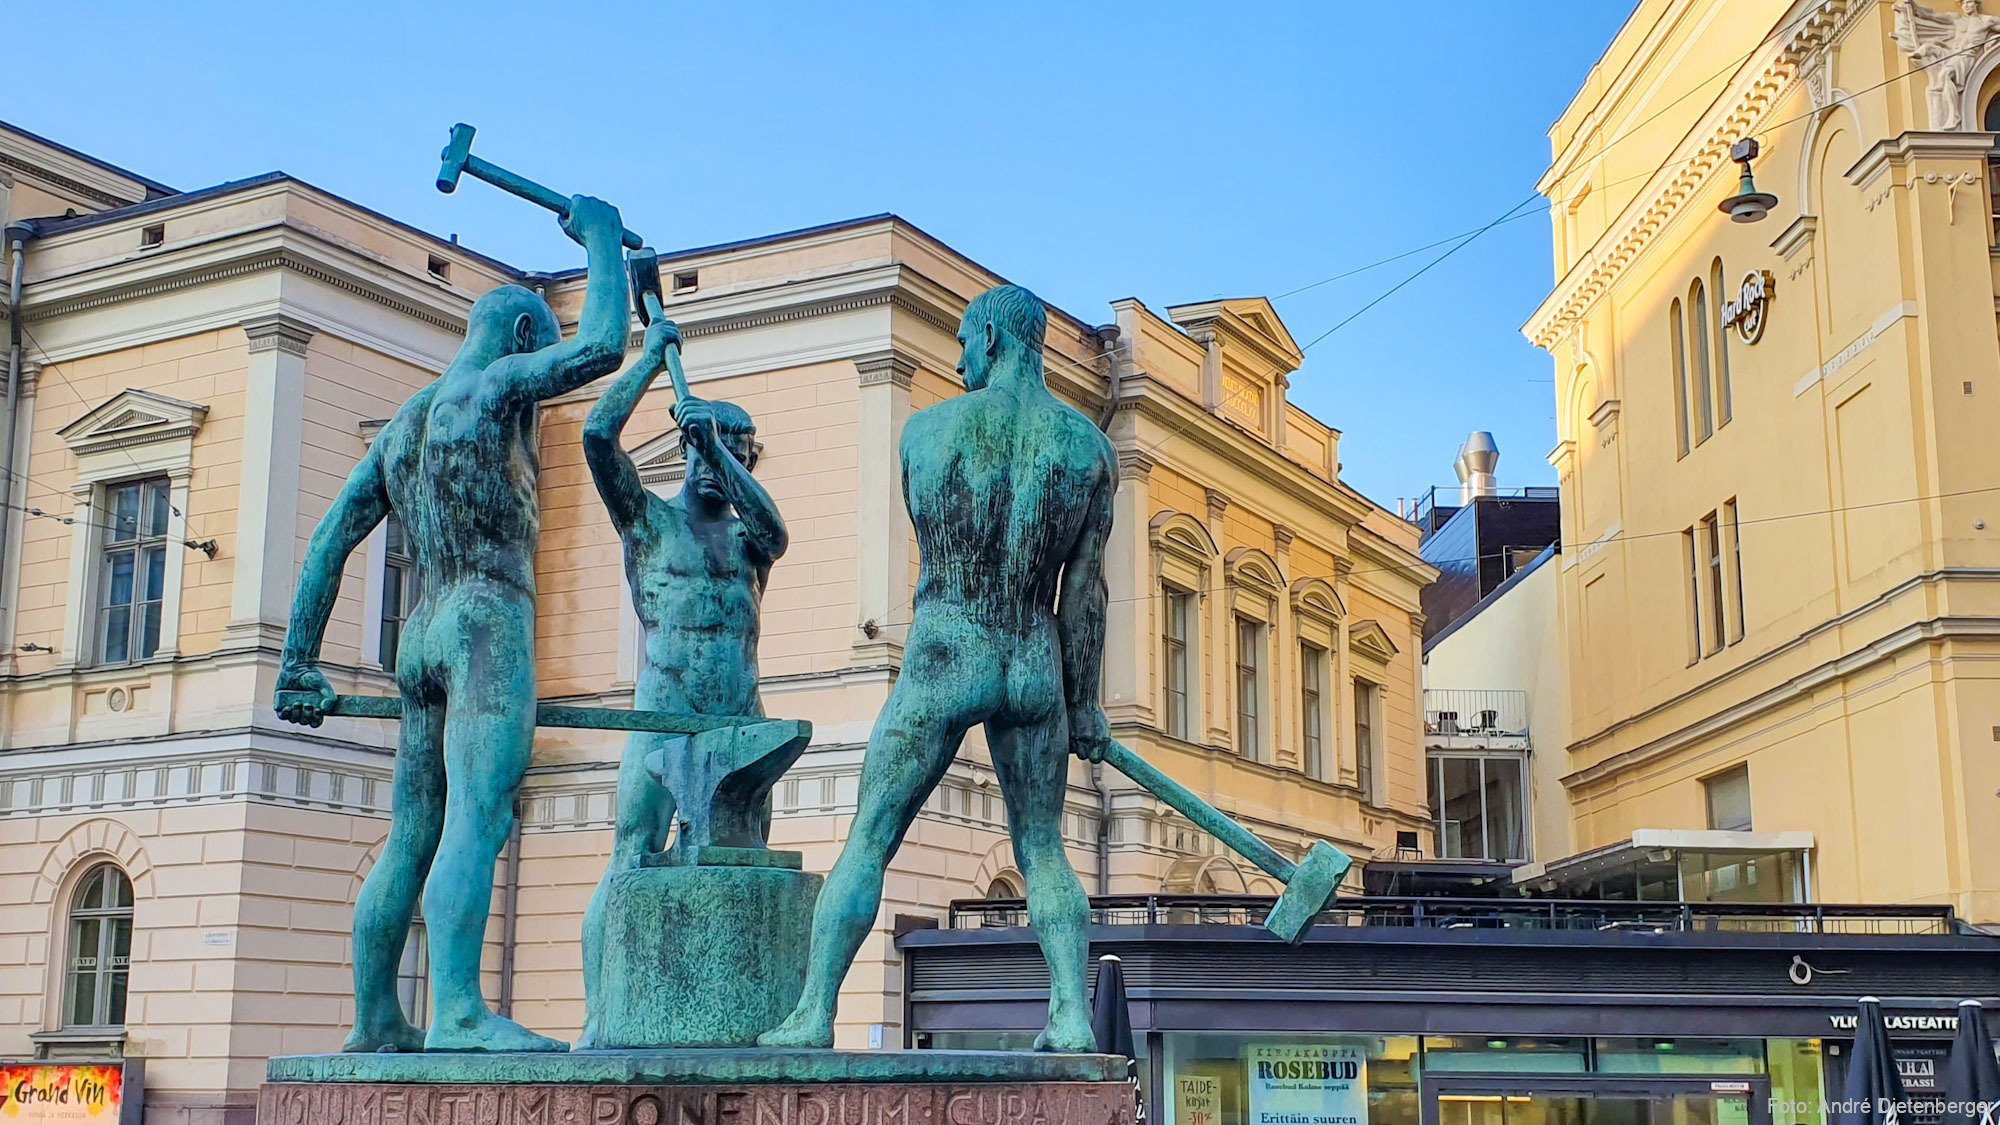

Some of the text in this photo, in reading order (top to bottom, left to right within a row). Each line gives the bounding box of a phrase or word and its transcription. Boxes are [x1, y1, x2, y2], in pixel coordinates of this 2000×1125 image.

[1721, 275, 1765, 328] Hard Rock
[1257, 1048, 1357, 1058] KIRJAKAUPPA
[1257, 1060, 1358, 1080] ROSEBUD
[15, 1077, 104, 1106] Grand Vin
[1180, 1080, 1217, 1095] TAIDE-
[1261, 1112, 1357, 1124] Erittäin suuren
